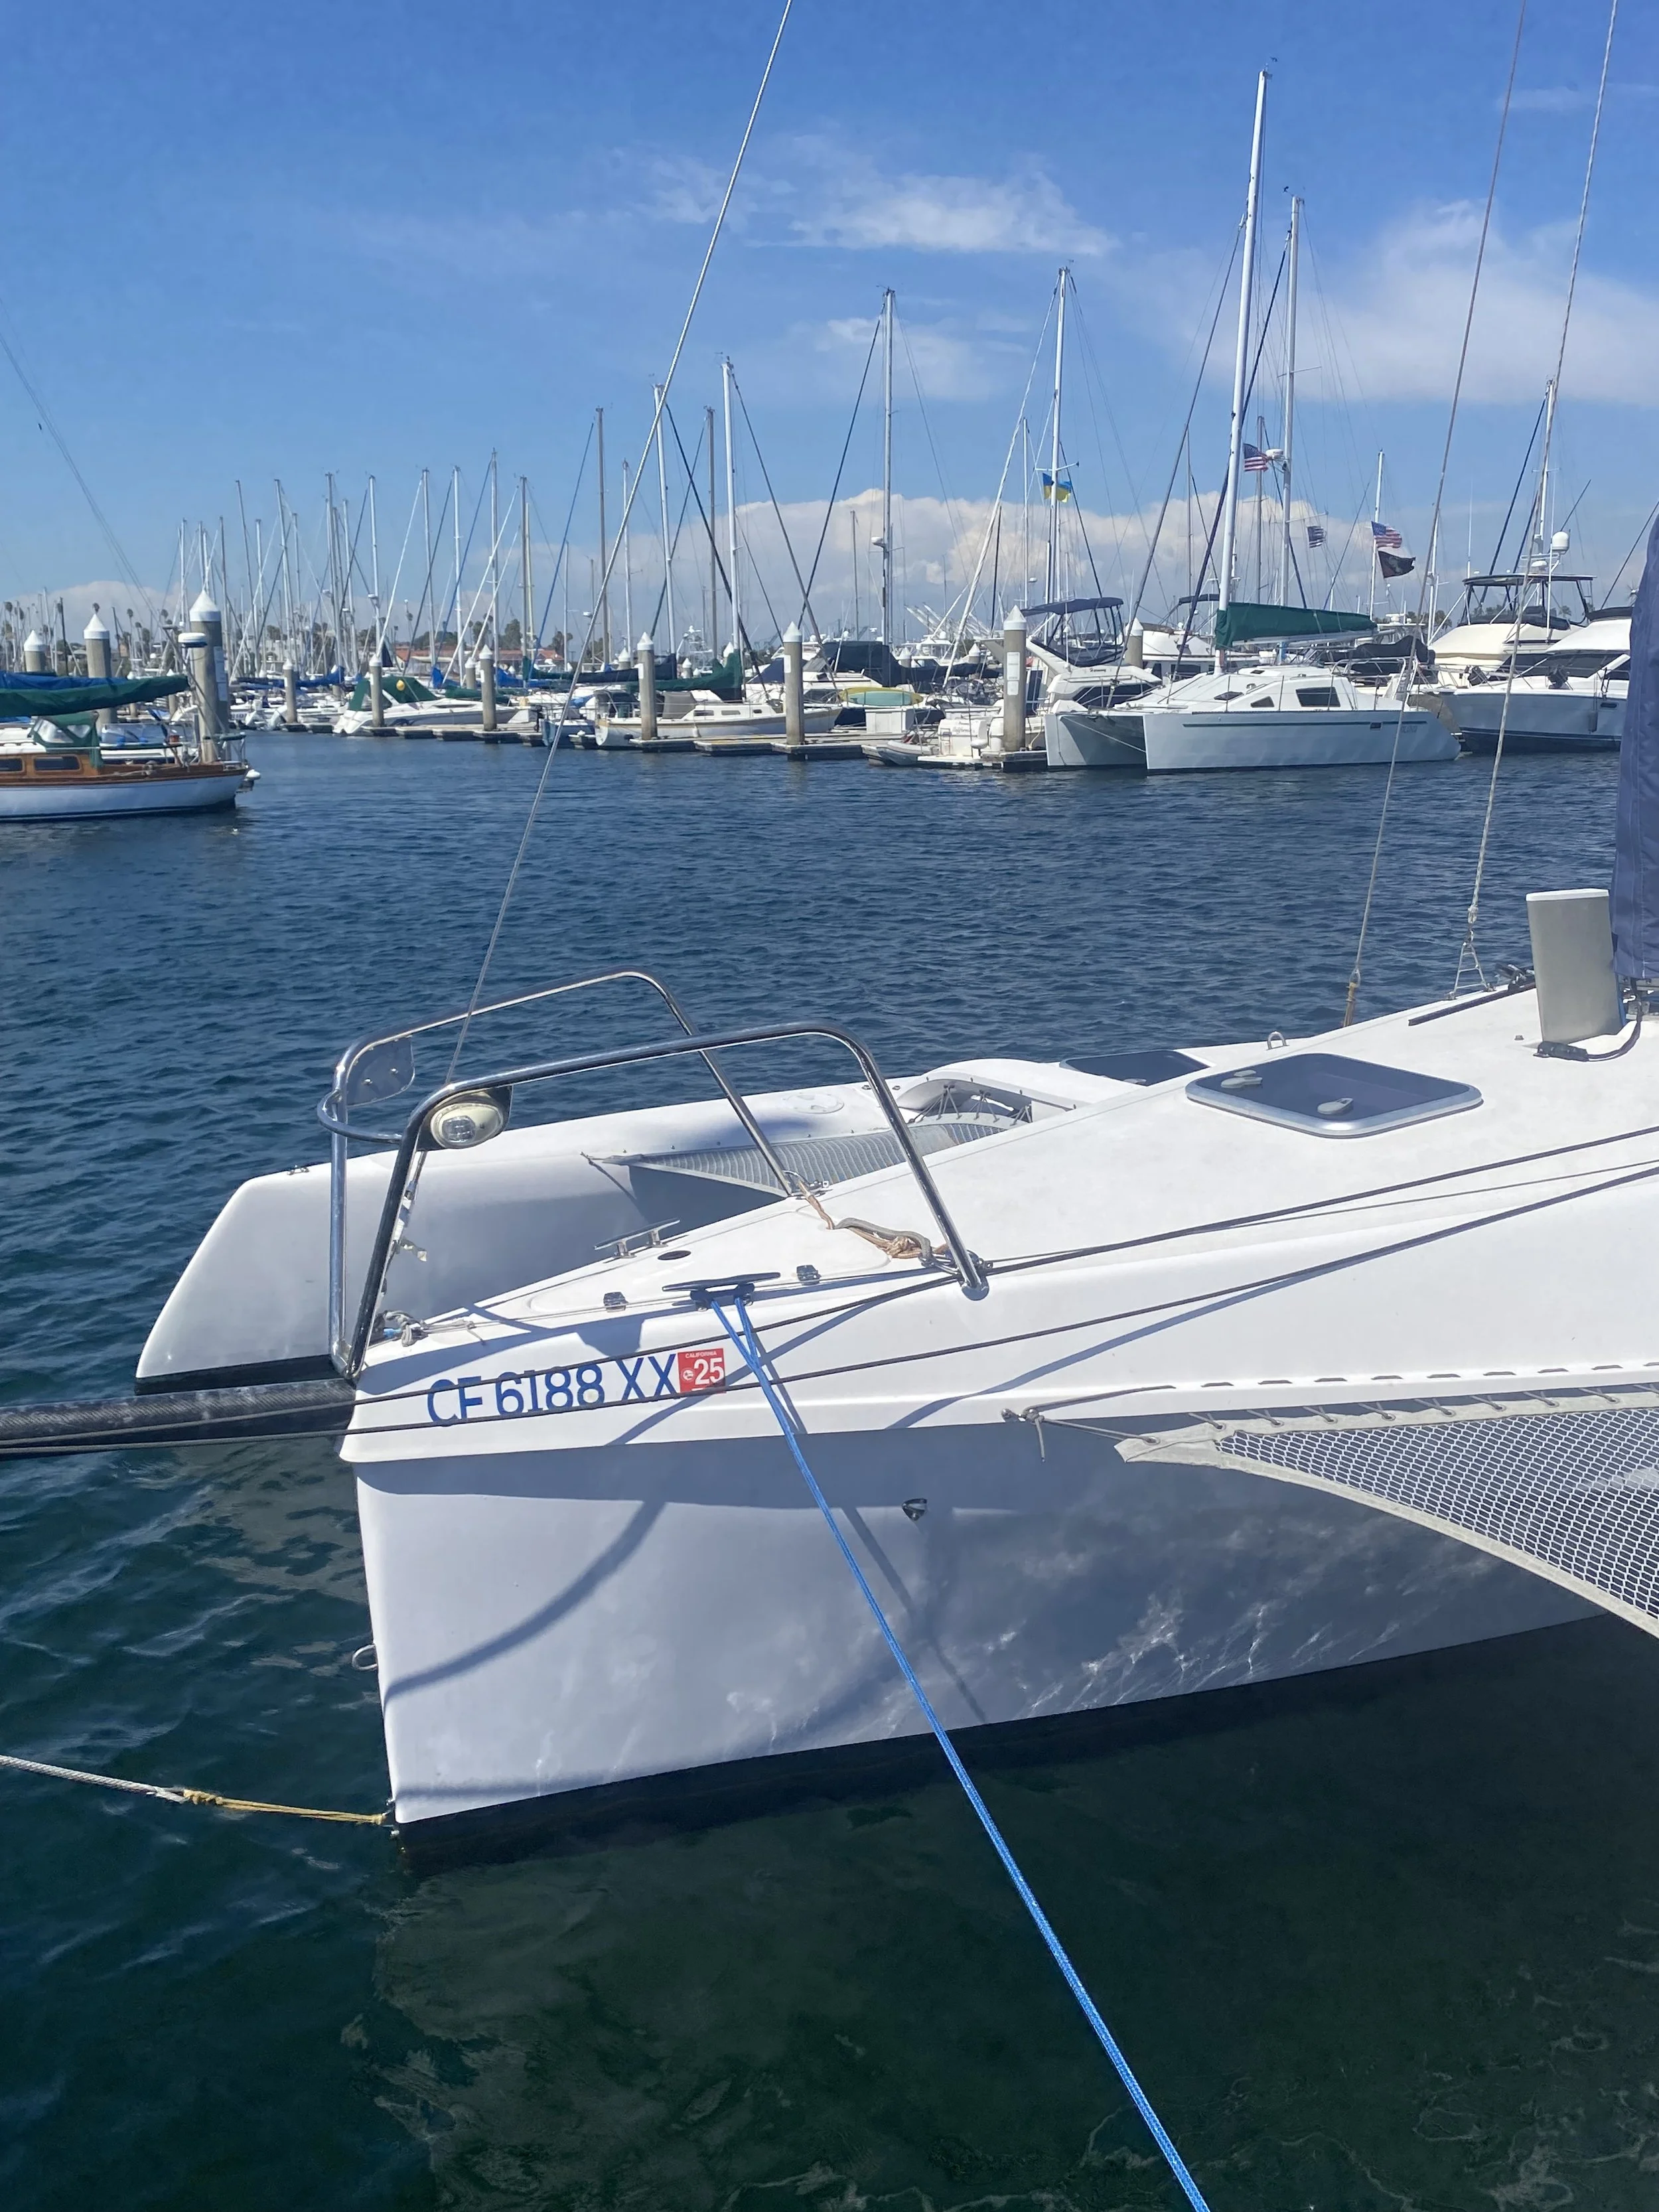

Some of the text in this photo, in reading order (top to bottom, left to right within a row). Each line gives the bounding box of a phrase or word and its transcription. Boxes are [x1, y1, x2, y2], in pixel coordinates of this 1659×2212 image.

[427, 1353, 677, 1426] CF 6188 XX
[693, 1357, 725, 1385] 25
